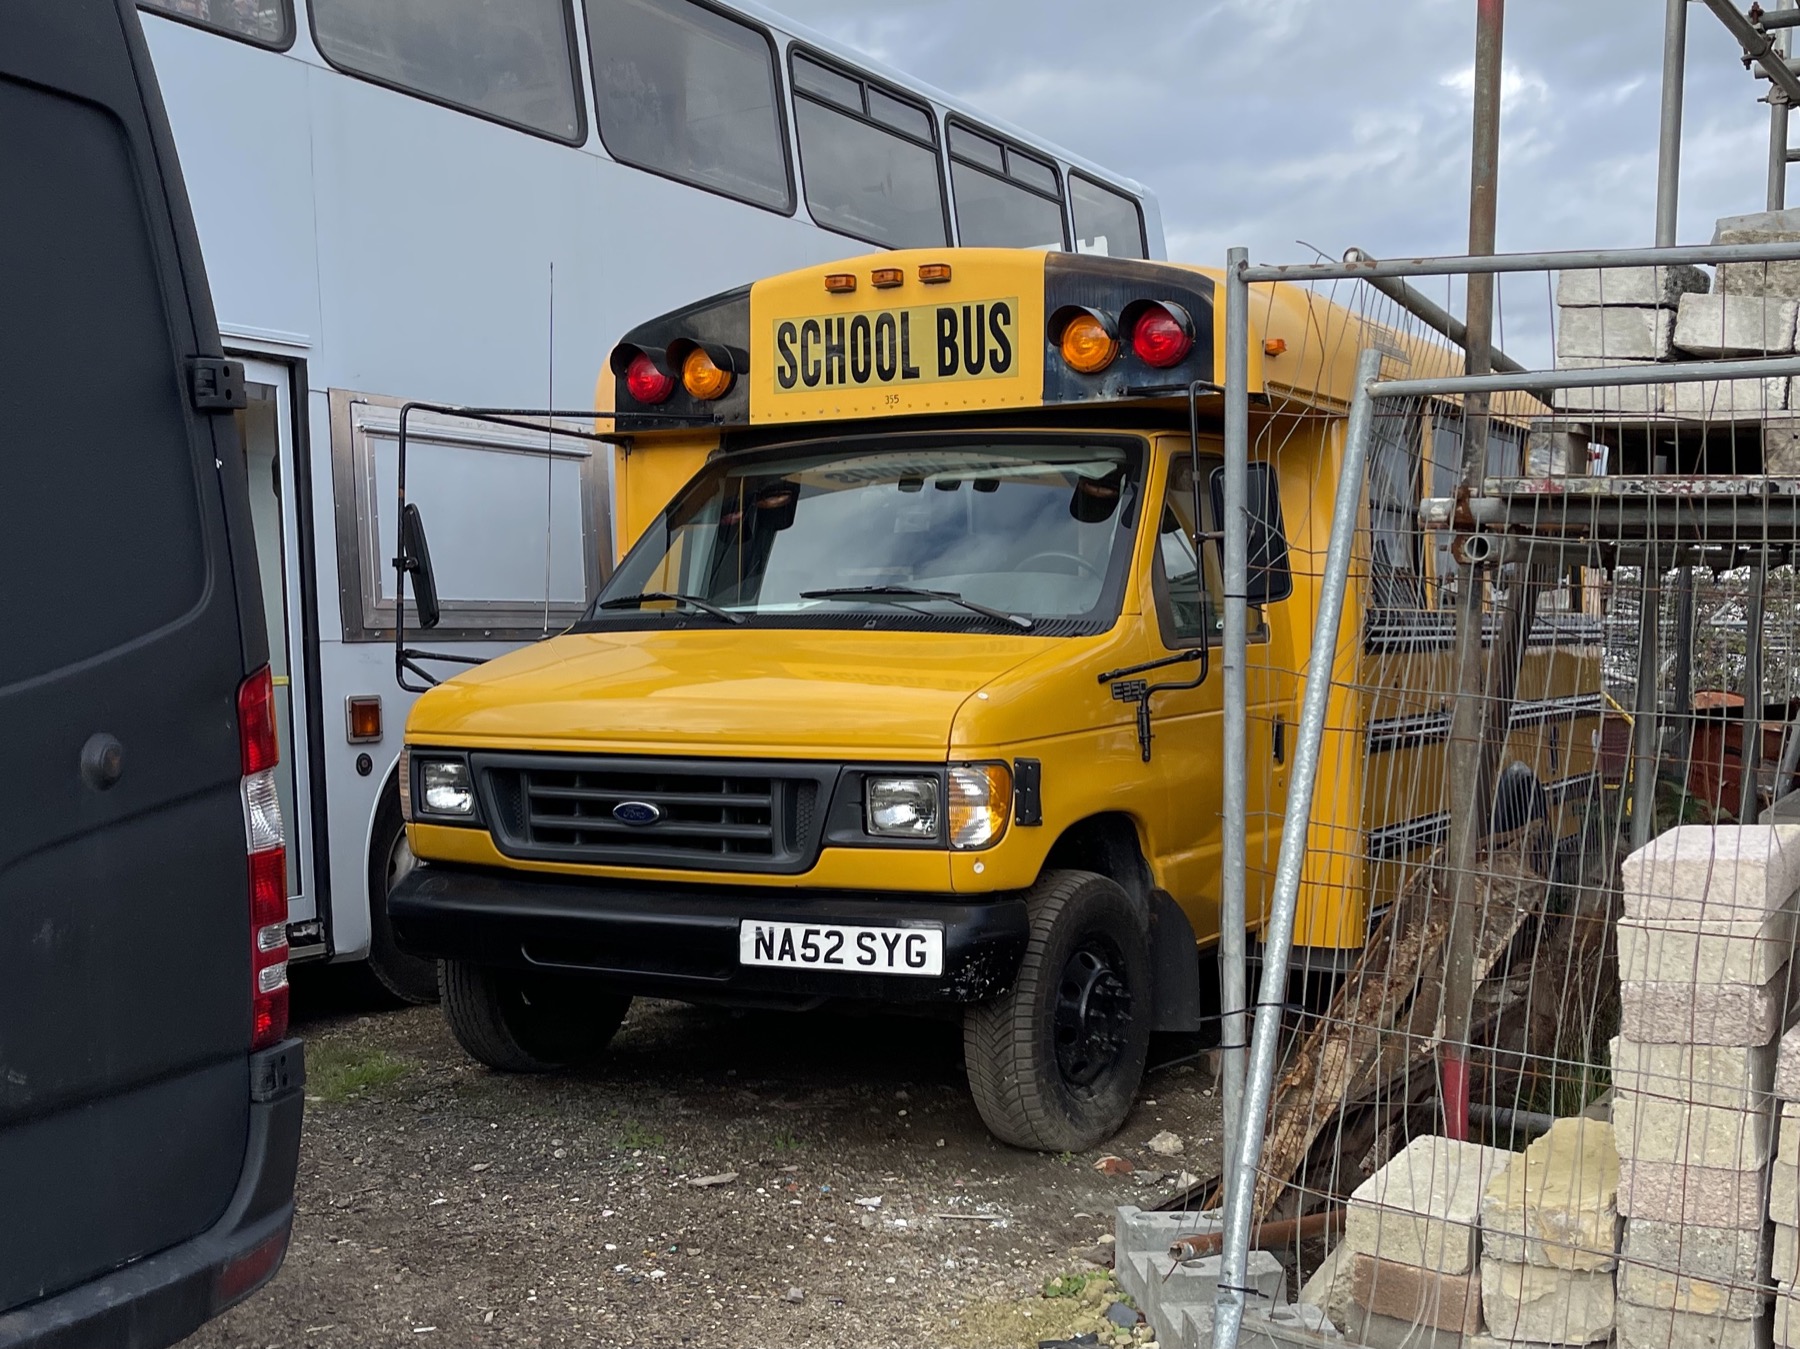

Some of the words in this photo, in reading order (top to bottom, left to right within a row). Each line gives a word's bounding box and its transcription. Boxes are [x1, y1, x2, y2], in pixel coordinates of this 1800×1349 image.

[777, 311, 920, 389] SCHOOL
[936, 302, 1012, 377] BUS
[885, 394, 900, 405] 355
[1112, 681, 1147, 699] E350
[754, 926, 844, 964] NA52
[856, 931, 927, 968] SYG
